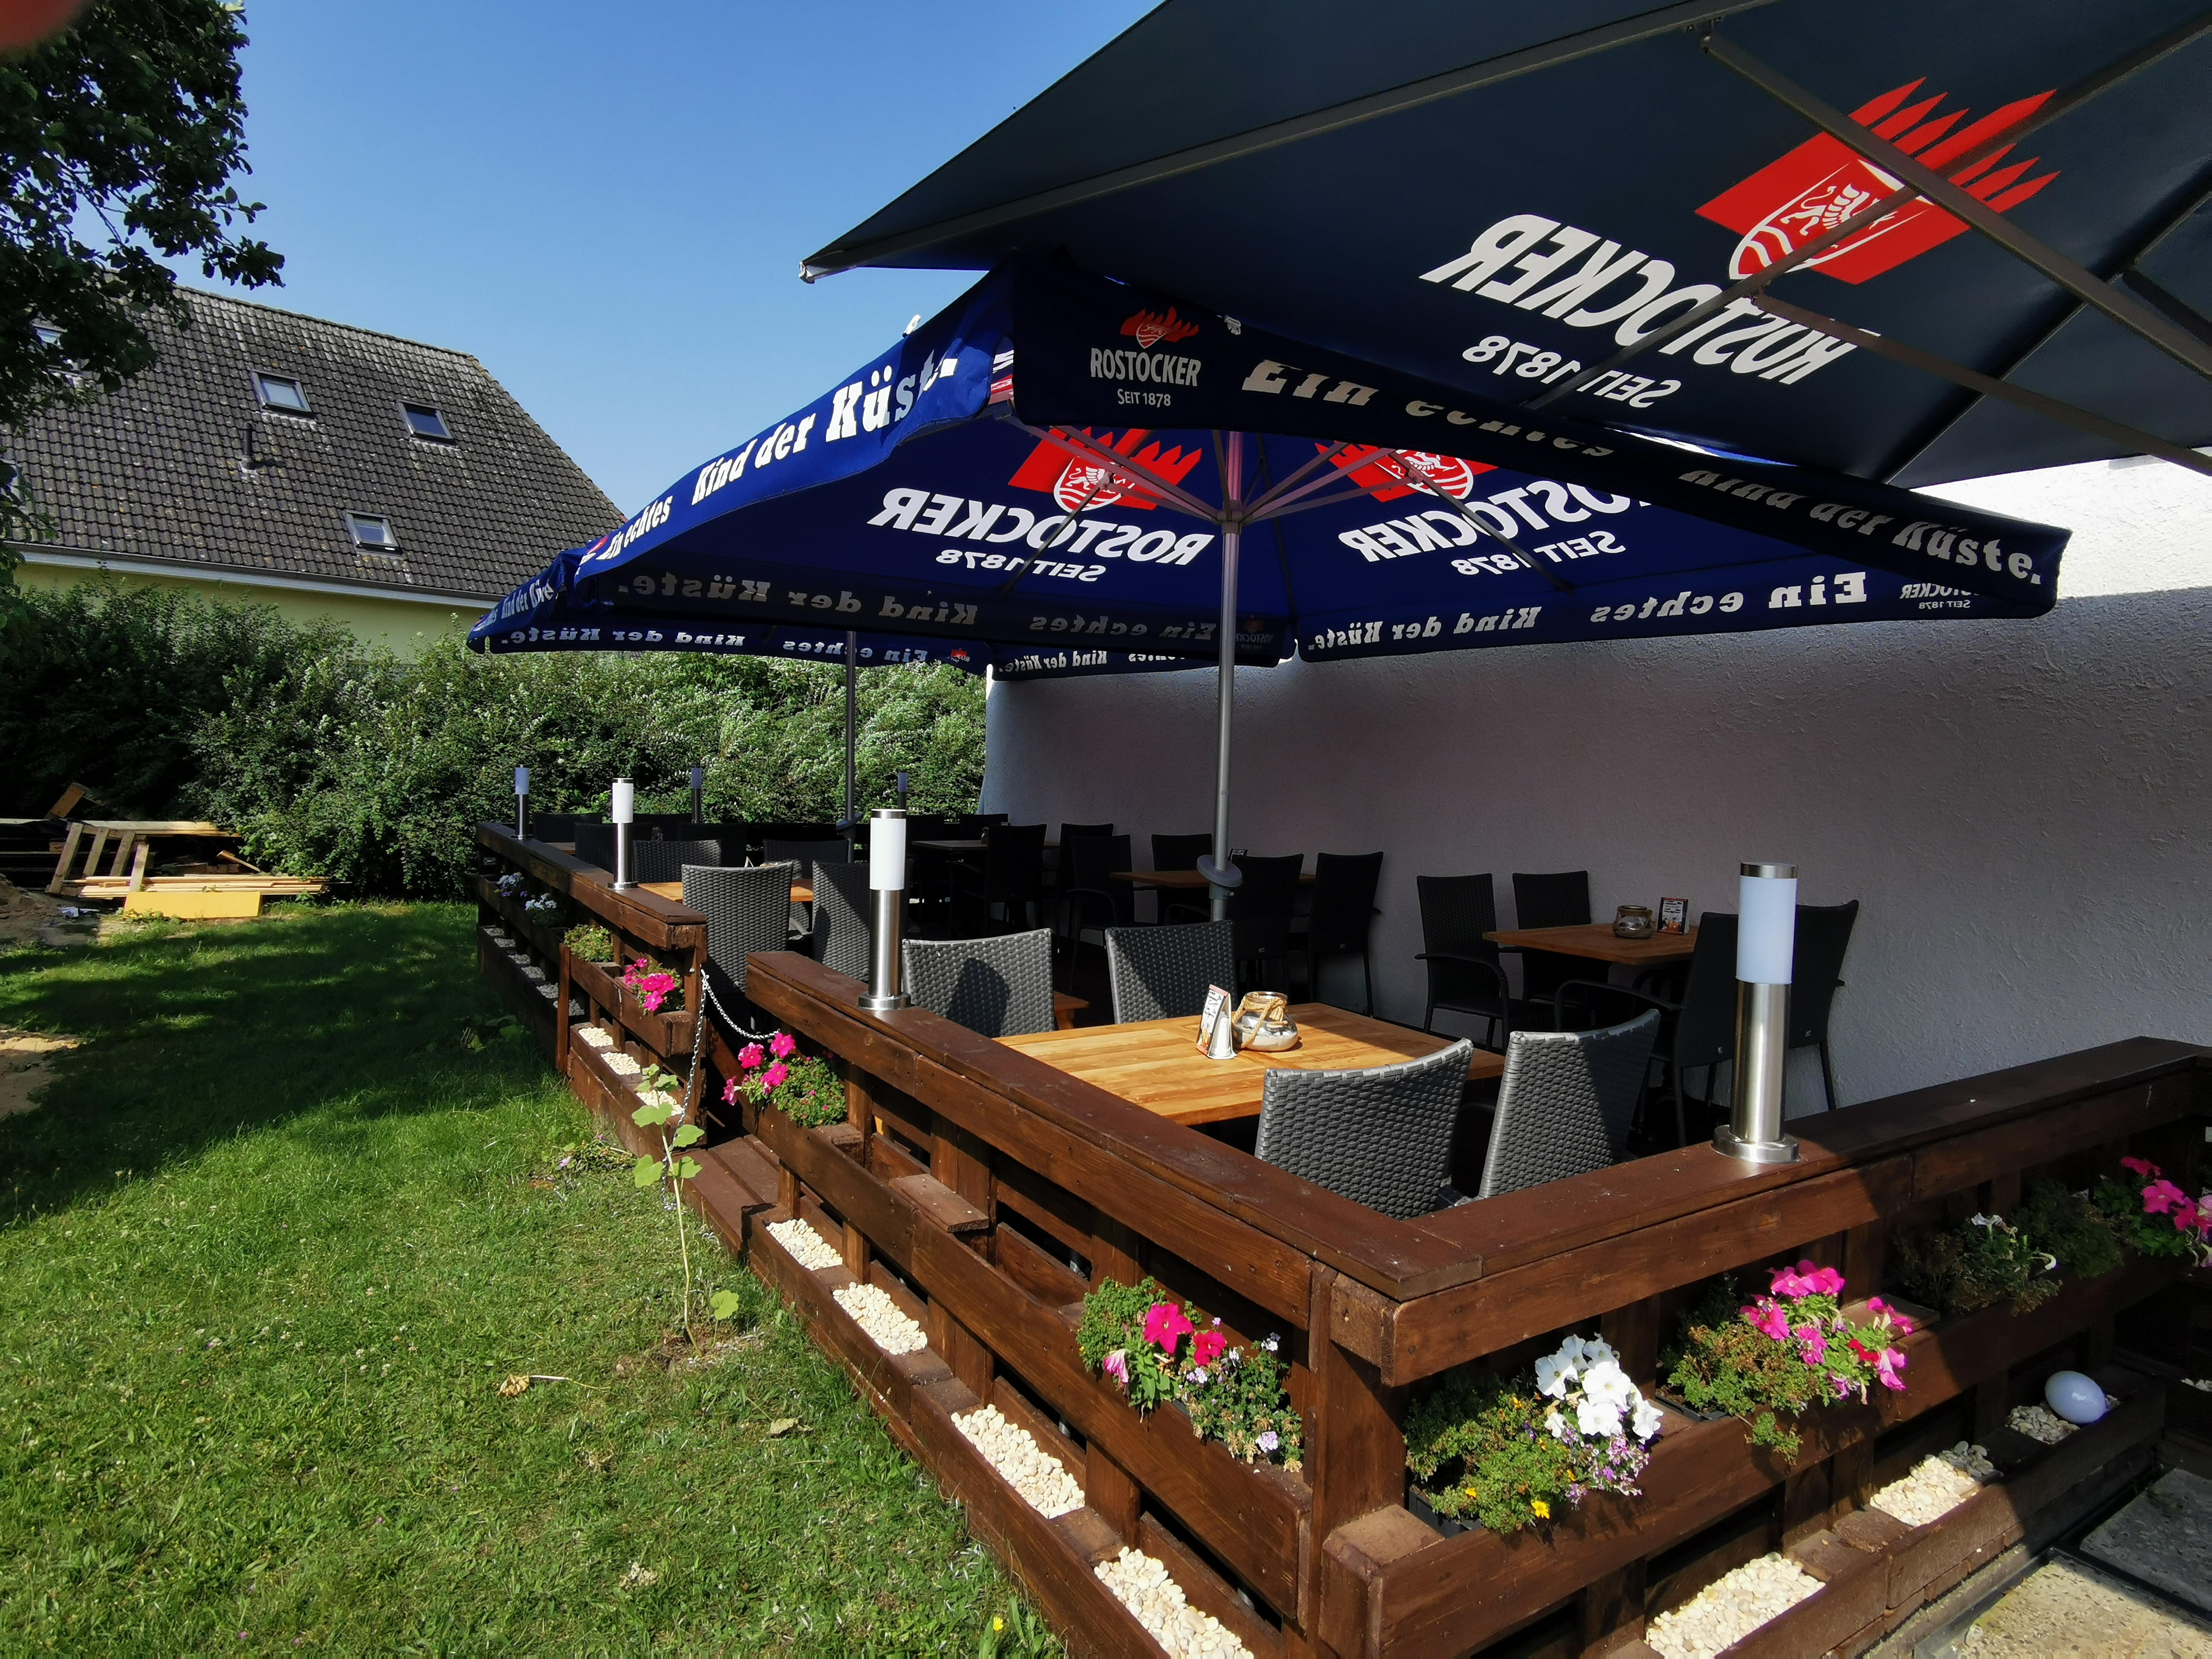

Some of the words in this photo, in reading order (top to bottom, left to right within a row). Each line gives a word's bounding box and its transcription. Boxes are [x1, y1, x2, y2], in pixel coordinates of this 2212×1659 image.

[1090, 347, 1201, 387] ROSTOCKER
[1117, 388, 1140, 405] SEIT
[1142, 392, 1171, 408] 1878
[595, 531, 624, 560] Ein
[623, 496, 673, 548] echtes
[692, 439, 757, 505] Kind
[755, 413, 816, 468] der
[826, 349, 958, 442] Küst.
[1241, 359, 1379, 406] Ein
[1892, 521, 2041, 585] Küste.
